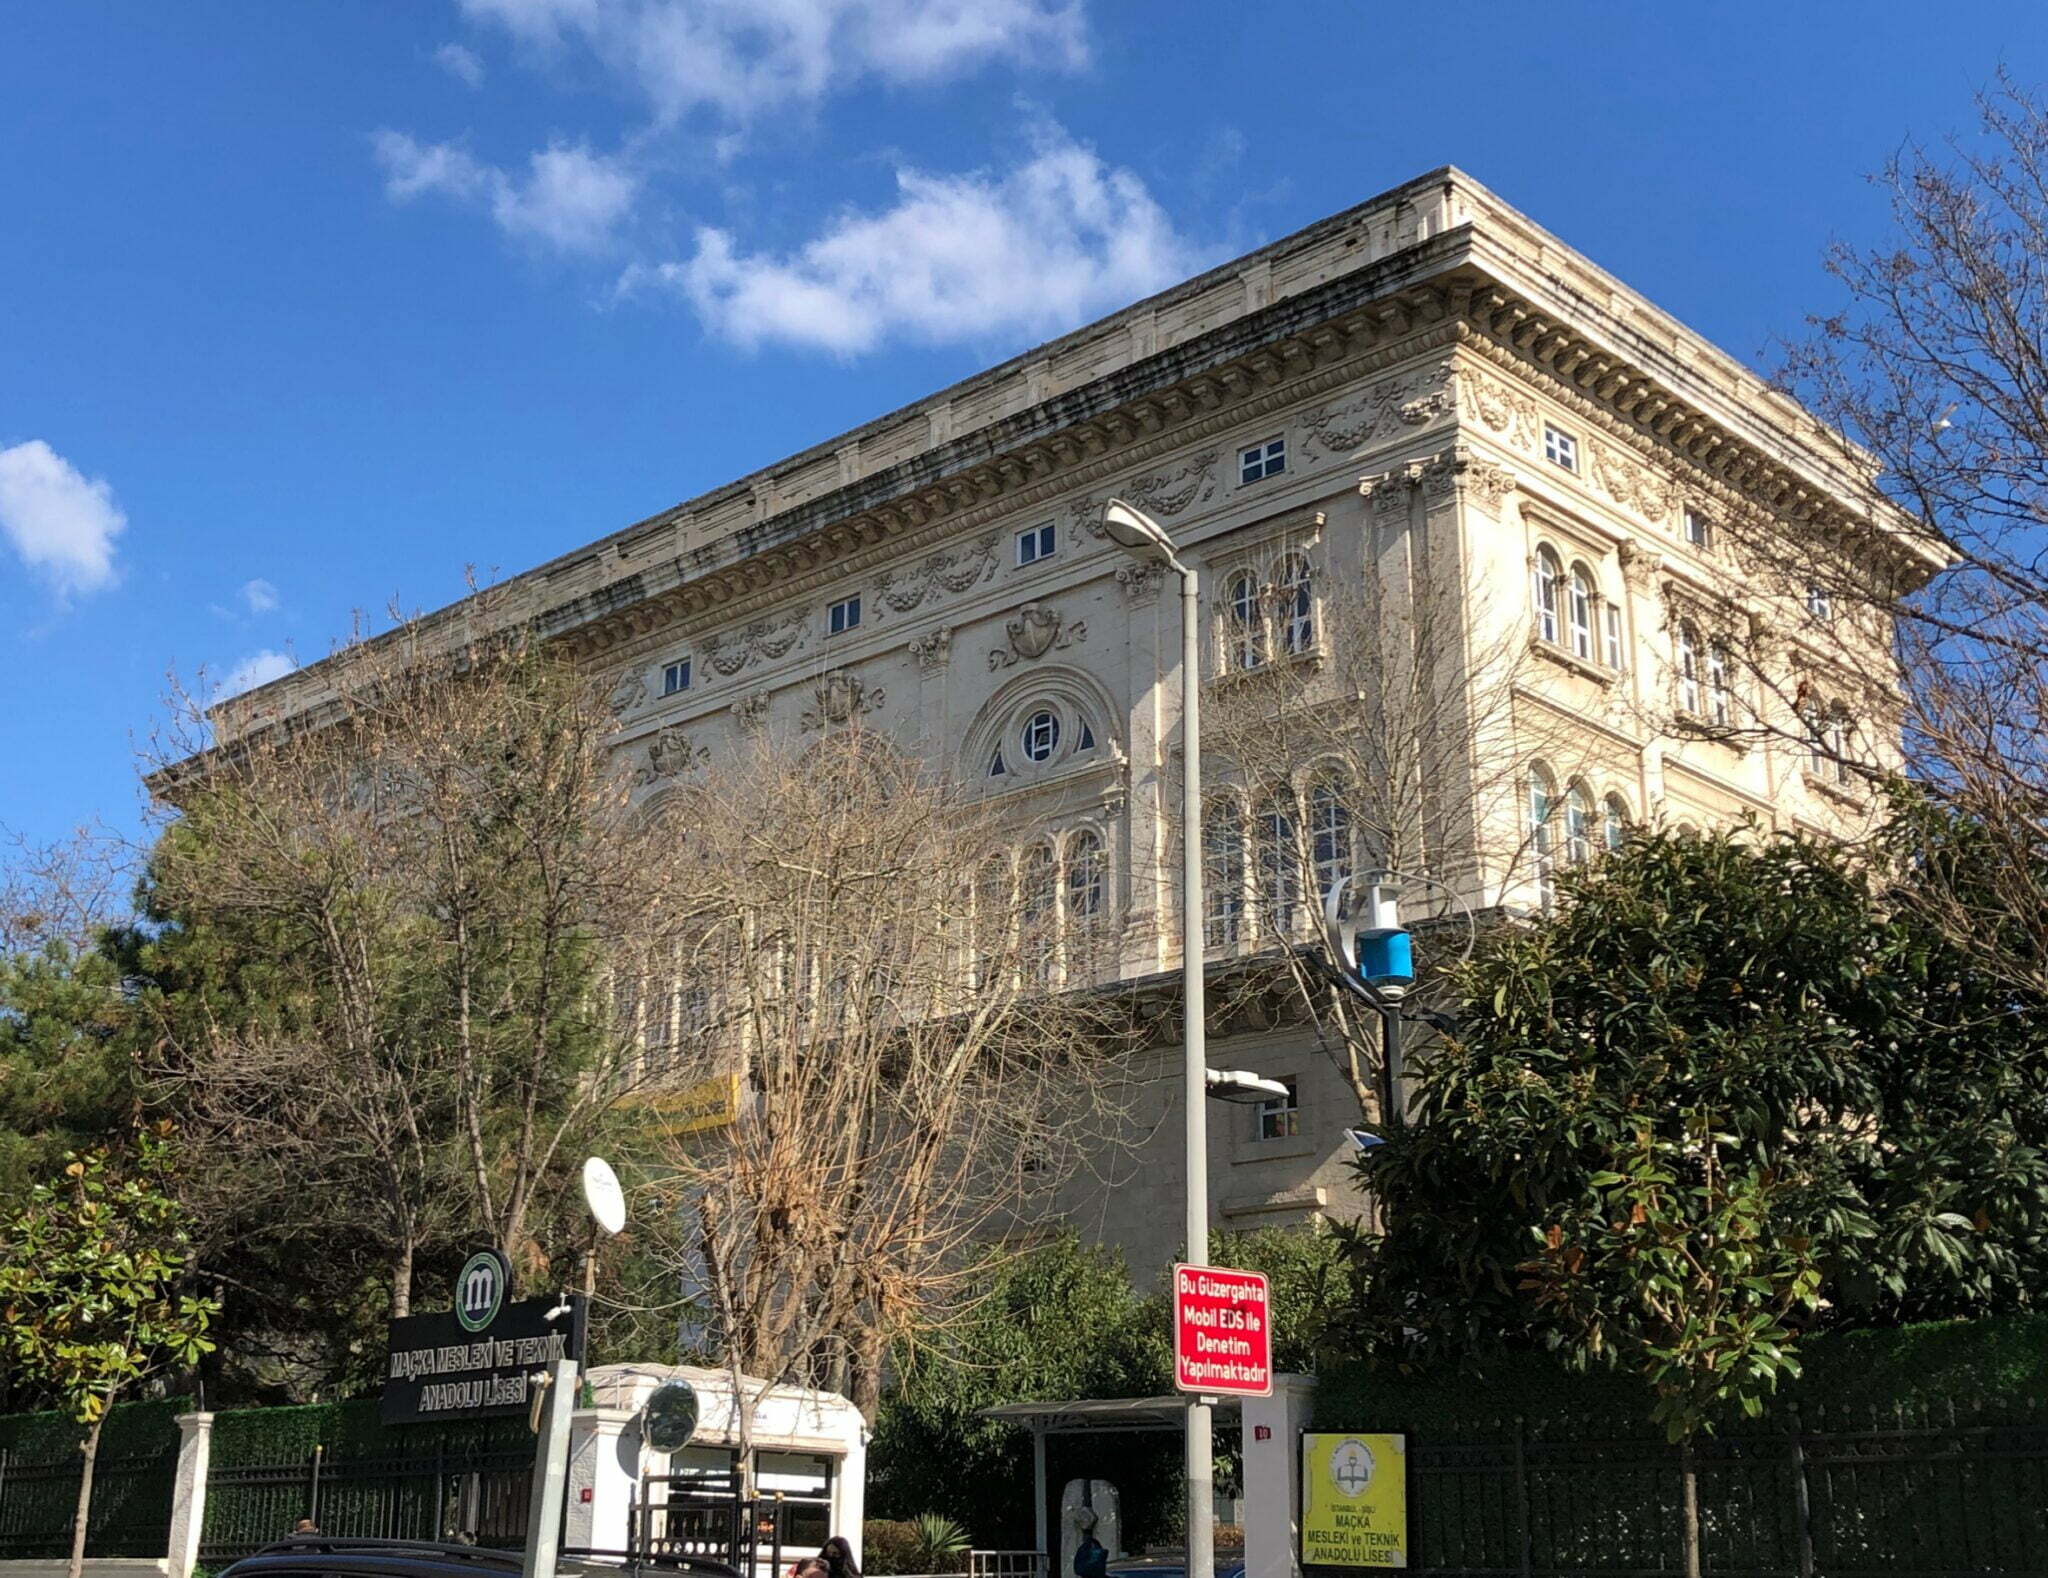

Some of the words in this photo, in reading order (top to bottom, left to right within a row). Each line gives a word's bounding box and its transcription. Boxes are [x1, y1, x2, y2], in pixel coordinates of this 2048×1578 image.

[1180, 1273, 1196, 1295] Bu
[1198, 1276, 1265, 1304] Güzergahta
[1184, 1304, 1217, 1327] Mobil
[1220, 1308, 1244, 1330] EDS
[1246, 1311, 1261, 1332] ile
[390, 1347, 436, 1382] MAÇKA
[436, 1336, 494, 1374] MESLEKİ
[494, 1339, 514, 1368] VE
[515, 1329, 568, 1364] TEKNİK
[1197, 1332, 1250, 1355] Denetim
[1182, 1355, 1266, 1382] Yapılmaktadır
[418, 1379, 484, 1413] ANADOLU
[484, 1370, 528, 1405] LİSESİ
[1335, 1514, 1371, 1531] MAÇKA
[1307, 1530, 1349, 1544] MESLEKİ
[1351, 1535, 1362, 1545] ve
[1364, 1530, 1400, 1547] TEKNİK
[1312, 1547, 1361, 1561] ANADOLU
